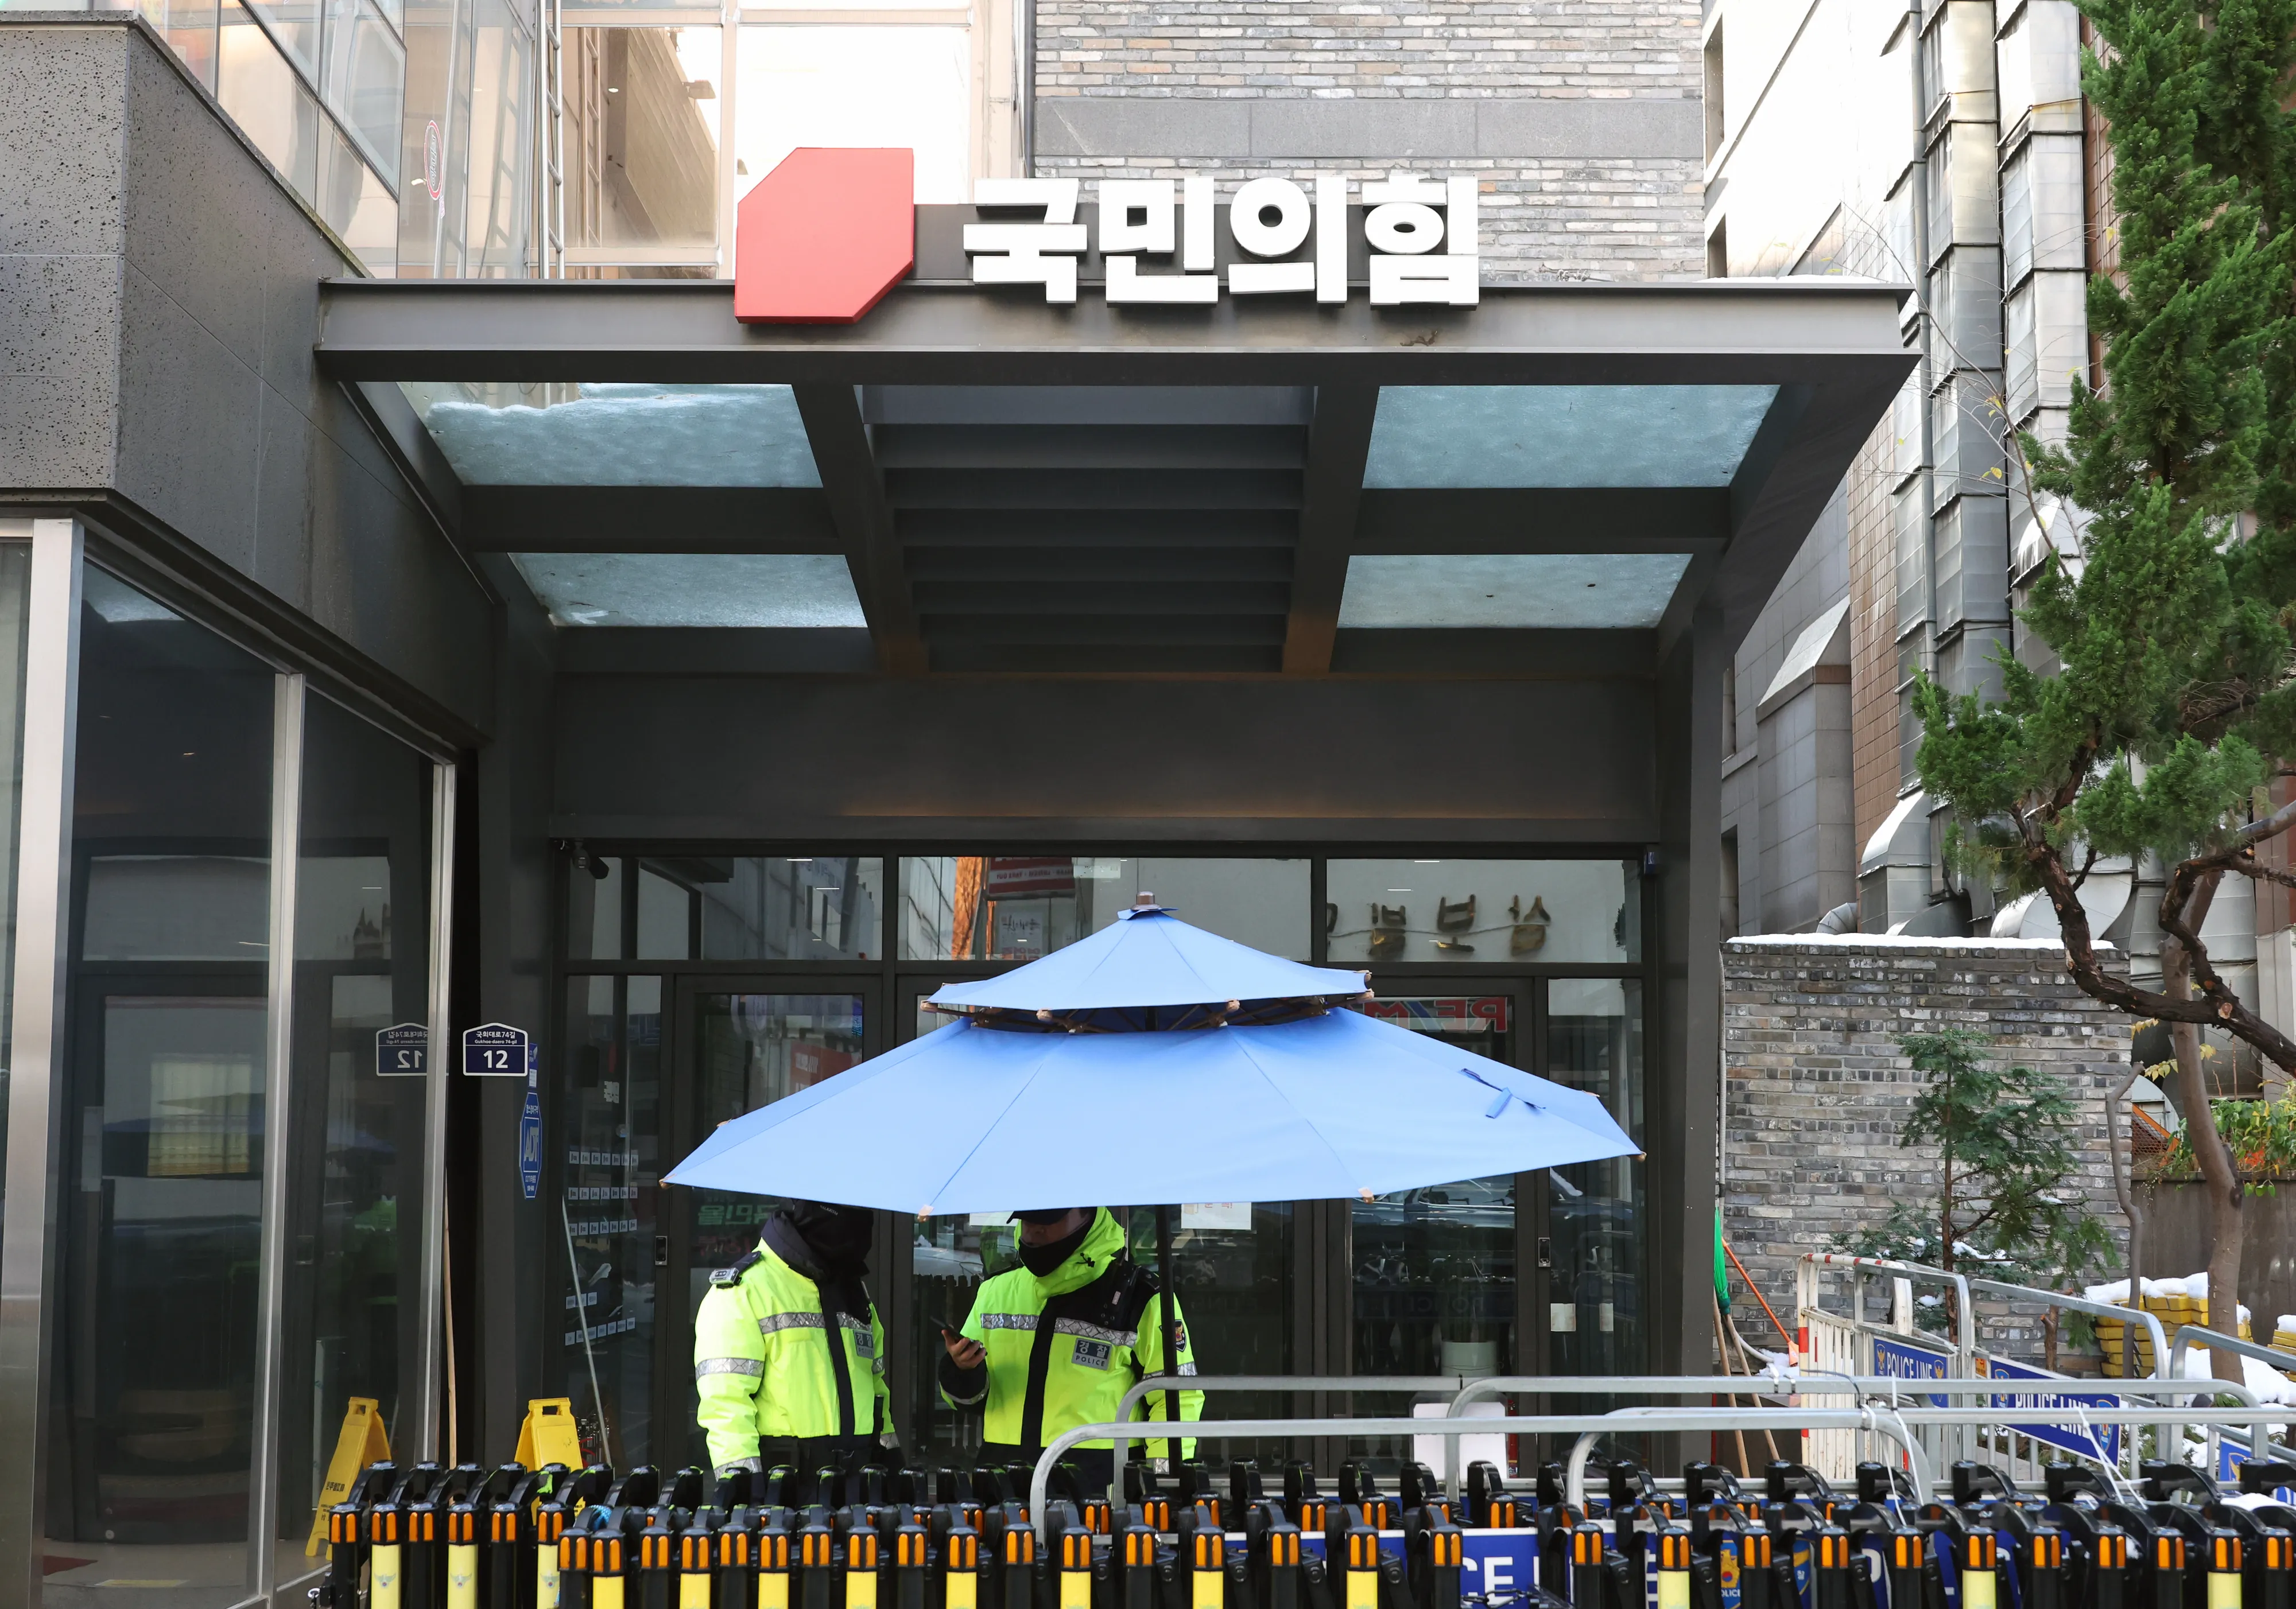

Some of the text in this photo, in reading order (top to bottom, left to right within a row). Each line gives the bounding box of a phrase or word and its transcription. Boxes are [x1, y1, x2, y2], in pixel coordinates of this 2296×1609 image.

[963, 175, 1479, 308] 국민의힘
[476, 1031, 515, 1039] 국회대로74길
[483, 1050, 508, 1068] 12
[524, 1126, 539, 1162] ADT
[856, 1333, 872, 1347] 경찰
[1079, 1341, 1107, 1358] 경찰
[1076, 1355, 1105, 1367] POLICE
[1887, 1352, 1933, 1379] POLICE LINE
